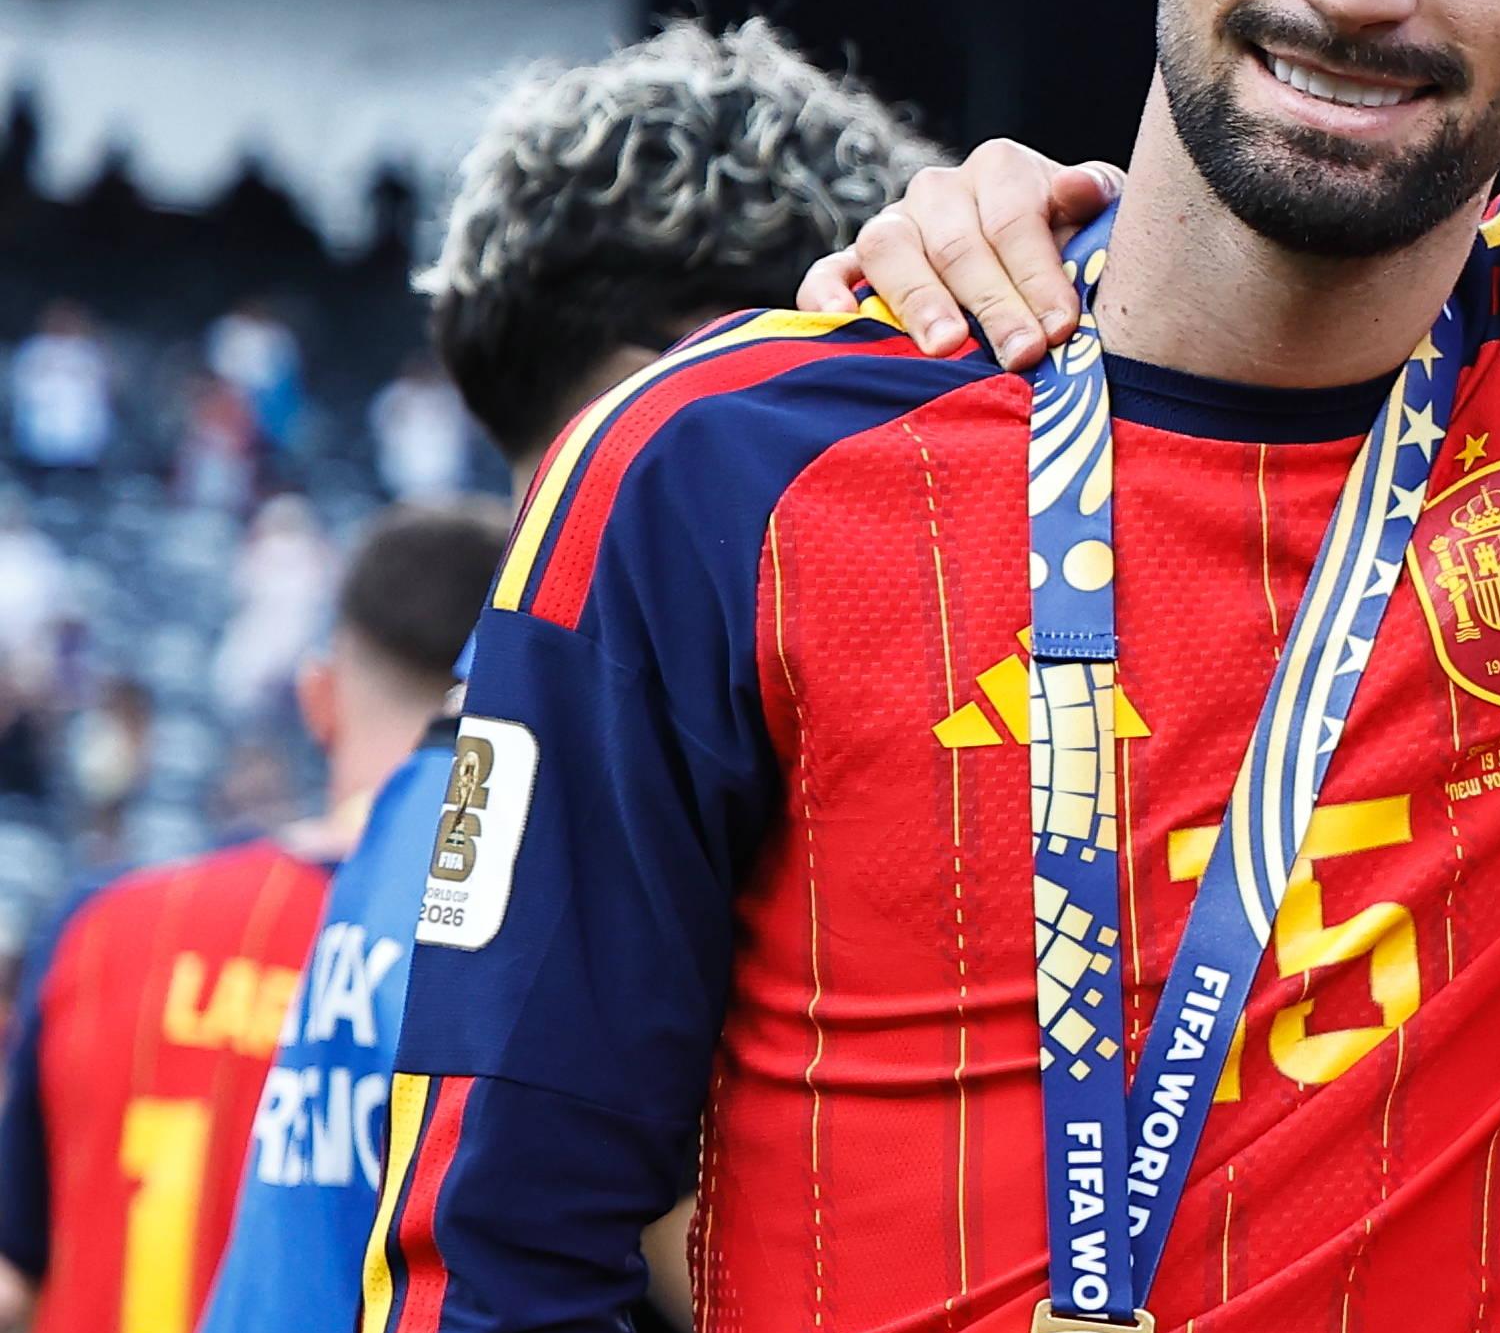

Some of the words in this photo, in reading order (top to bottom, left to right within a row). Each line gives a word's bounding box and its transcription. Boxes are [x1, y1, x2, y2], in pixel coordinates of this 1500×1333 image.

[1485, 660, 1500, 676] 19
[1166, 965, 1230, 1061] FIFA
[1066, 1121, 1104, 1225] FIFA
